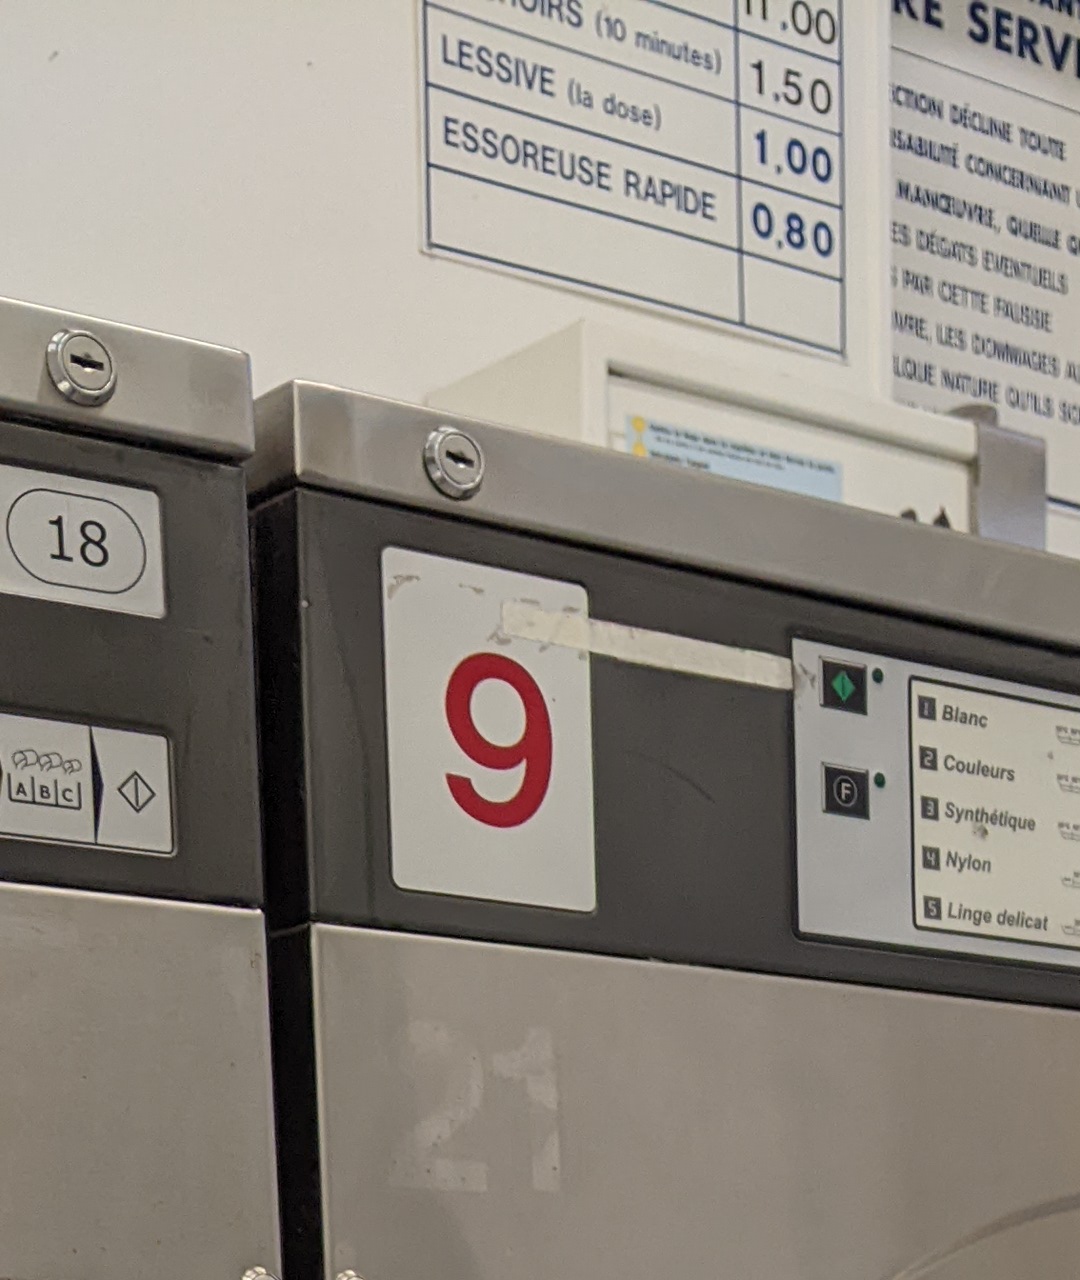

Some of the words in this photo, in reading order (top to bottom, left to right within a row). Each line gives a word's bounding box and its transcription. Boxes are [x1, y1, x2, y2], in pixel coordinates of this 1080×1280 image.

[595, 9, 627, 42] (10
[634, 29, 722, 75] minutes)
[441, 34, 556, 97] LESSIVE
[567, 77, 594, 109] (la
[602, 93, 662, 131] dose)
[751, 60, 832, 115] 1.50
[755, 129, 832, 183] 1.00
[950, 102, 1013, 144] DÉCLINE
[1018, 126, 1067, 161] TOUTE
[443, 116, 612, 192] ESSOREUSE
[623, 168, 717, 222] RAPIDE
[965, 153, 1071, 204] CONCERNANT
[753, 202, 833, 258] 0.80
[1006, 214, 1062, 250] QUELLE
[902, 268, 934, 299] PAR
[937, 279, 990, 315] CETTE
[993, 297, 1053, 333] FAUSSE
[935, 322, 967, 352] LES
[971, 331, 1061, 379] DOMMAGES
[940, 368, 999, 402] NATURE
[49, 515, 109, 568] 18
[445, 651, 553, 829] 9
[942, 704, 988, 728] Blanc
[16, 782, 27, 796] A
[40, 785, 51, 799] B
[62, 788, 73, 802] C
[841, 782, 852, 801] F
[944, 754, 1015, 781] Couleurs
[945, 801, 1036, 832] Synthétique
[945, 850, 992, 873] Nylon
[948, 902, 992, 926] Linge
[996, 909, 1049, 931] delicat
